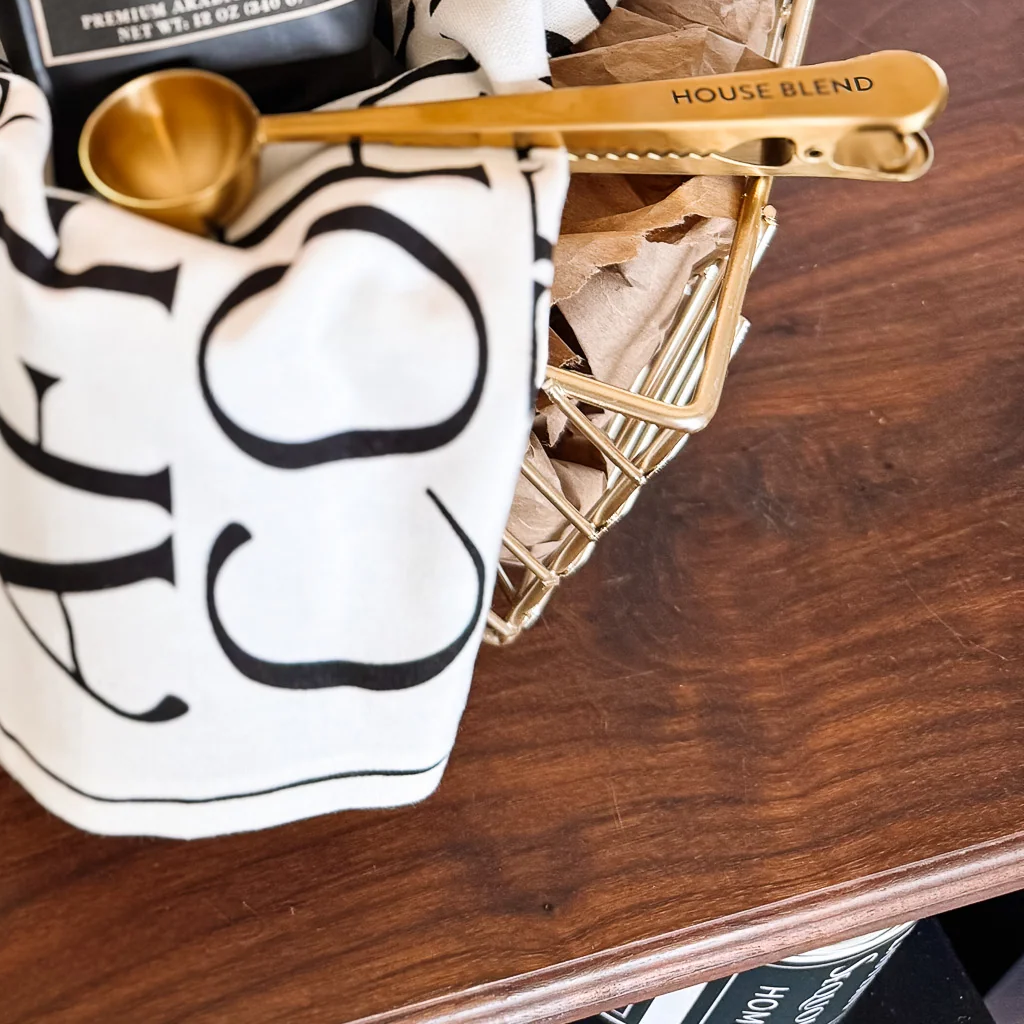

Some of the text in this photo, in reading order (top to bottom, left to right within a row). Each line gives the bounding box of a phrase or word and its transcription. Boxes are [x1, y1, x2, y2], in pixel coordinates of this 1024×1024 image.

[80, 2, 167, 30] PREMIUM
[116, 24, 154, 43] NET
[215, 4, 241, 23] OZ
[671, 76, 874, 104] HOUSE BLEND
